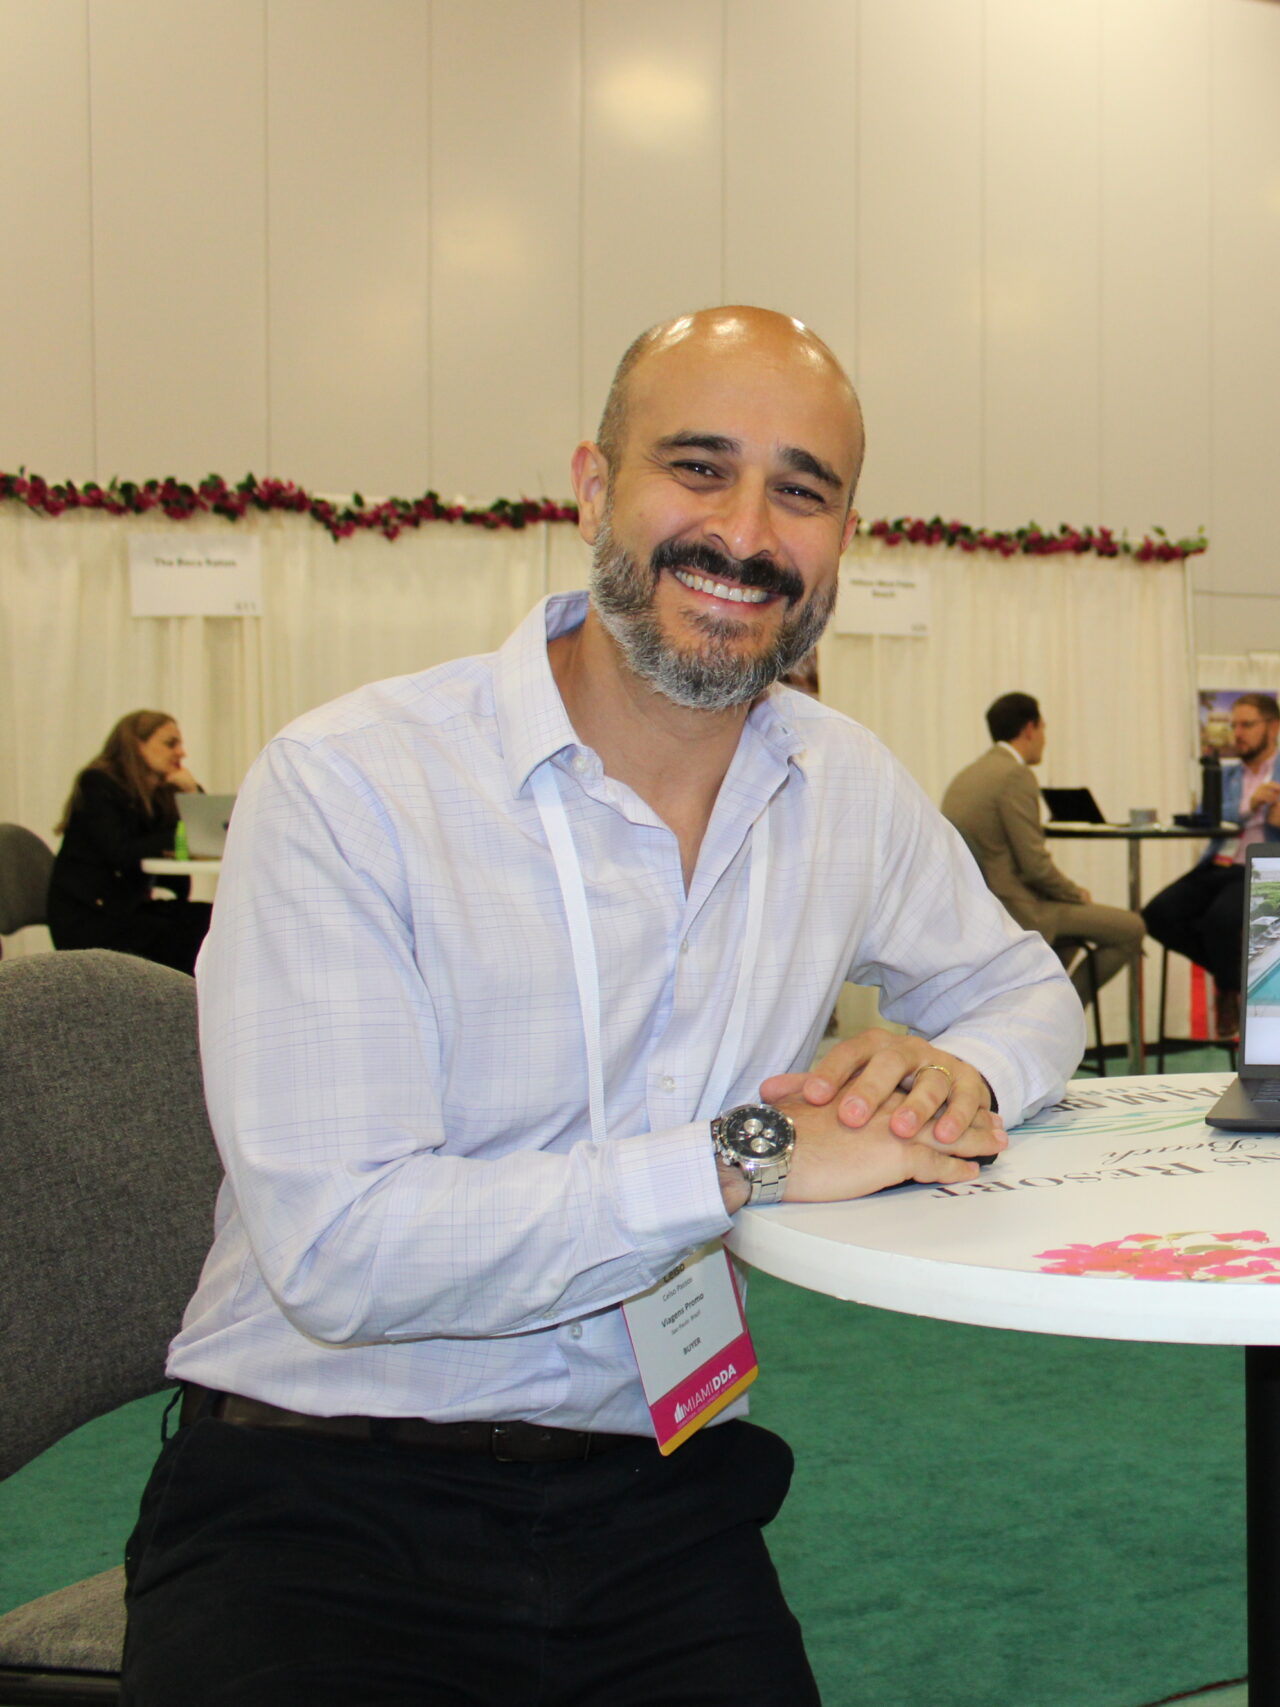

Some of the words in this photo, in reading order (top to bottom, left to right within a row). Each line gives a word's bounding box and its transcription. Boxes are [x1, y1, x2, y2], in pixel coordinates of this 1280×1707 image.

[1104, 1085, 1228, 1106] ALM
[1101, 1138, 1258, 1166] Beach
[931, 1161, 1212, 1199] RESORT
[661, 1307, 684, 1328] Viagens
[684, 1292, 704, 1311] Promo
[683, 1336, 701, 1355] BUYER
